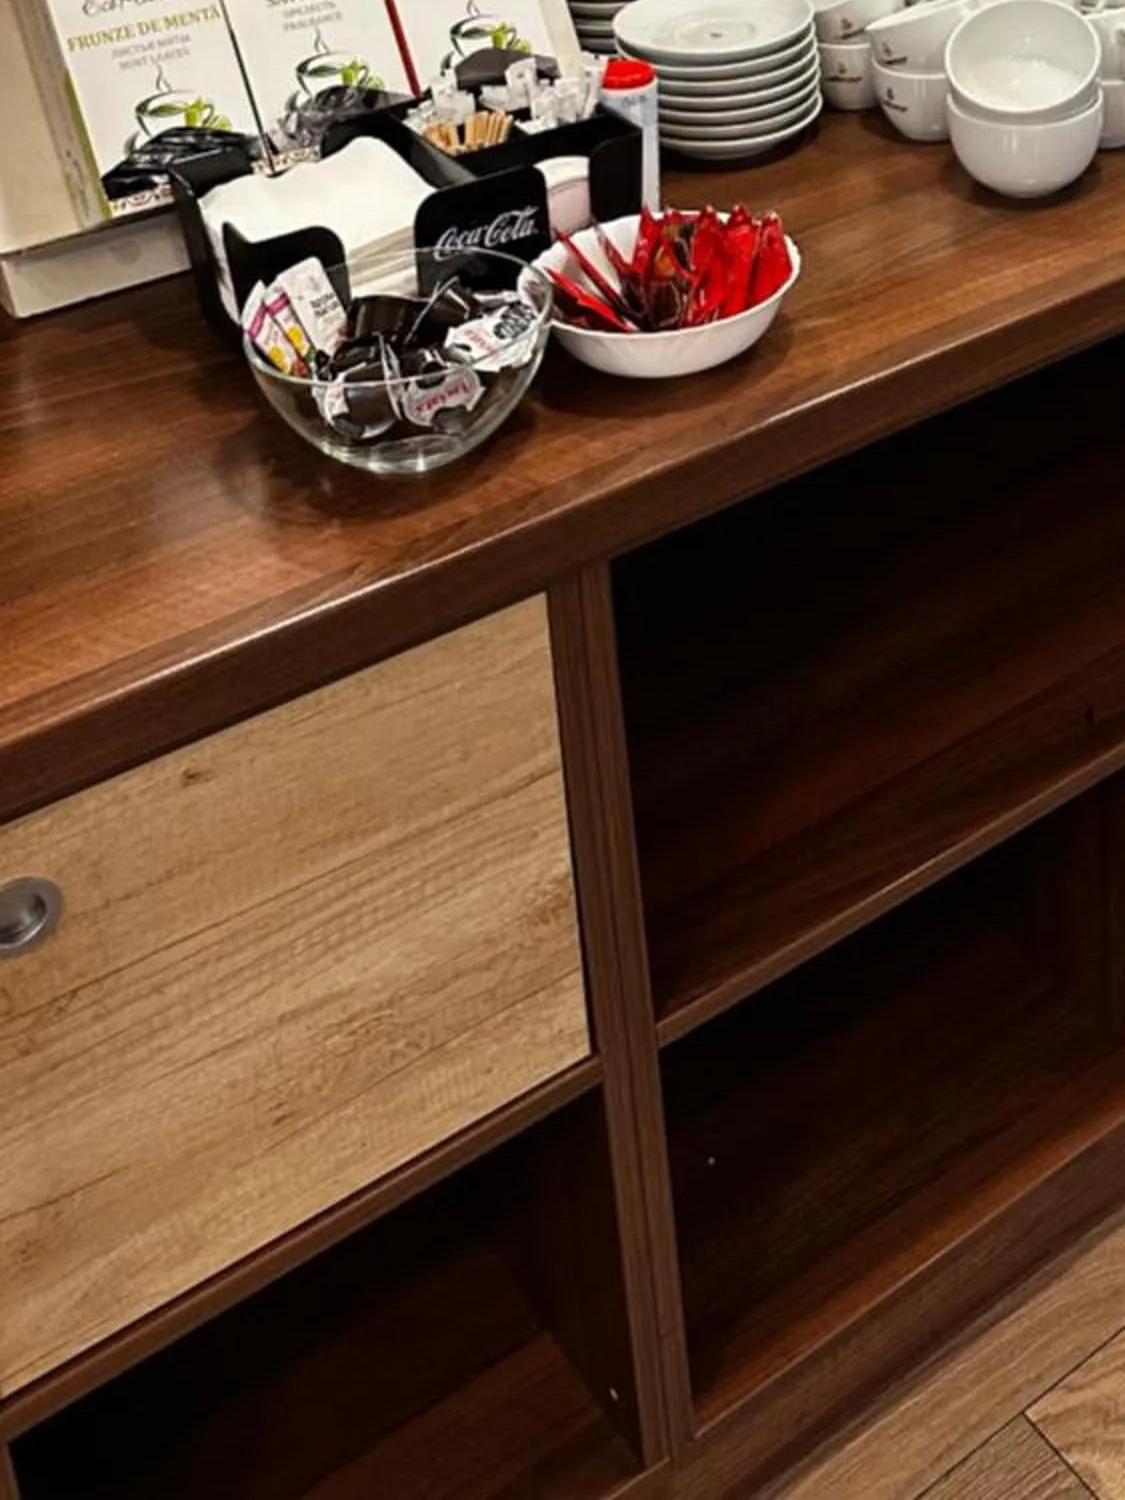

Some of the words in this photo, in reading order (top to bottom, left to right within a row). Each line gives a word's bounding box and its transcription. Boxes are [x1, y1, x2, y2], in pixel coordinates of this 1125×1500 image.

[67, 24, 136, 51] FRUNZE
[138, 18, 161, 35] DE
[163, 5, 221, 30] MENTĂ
[433, 205, 539, 262] Coca-Cola
